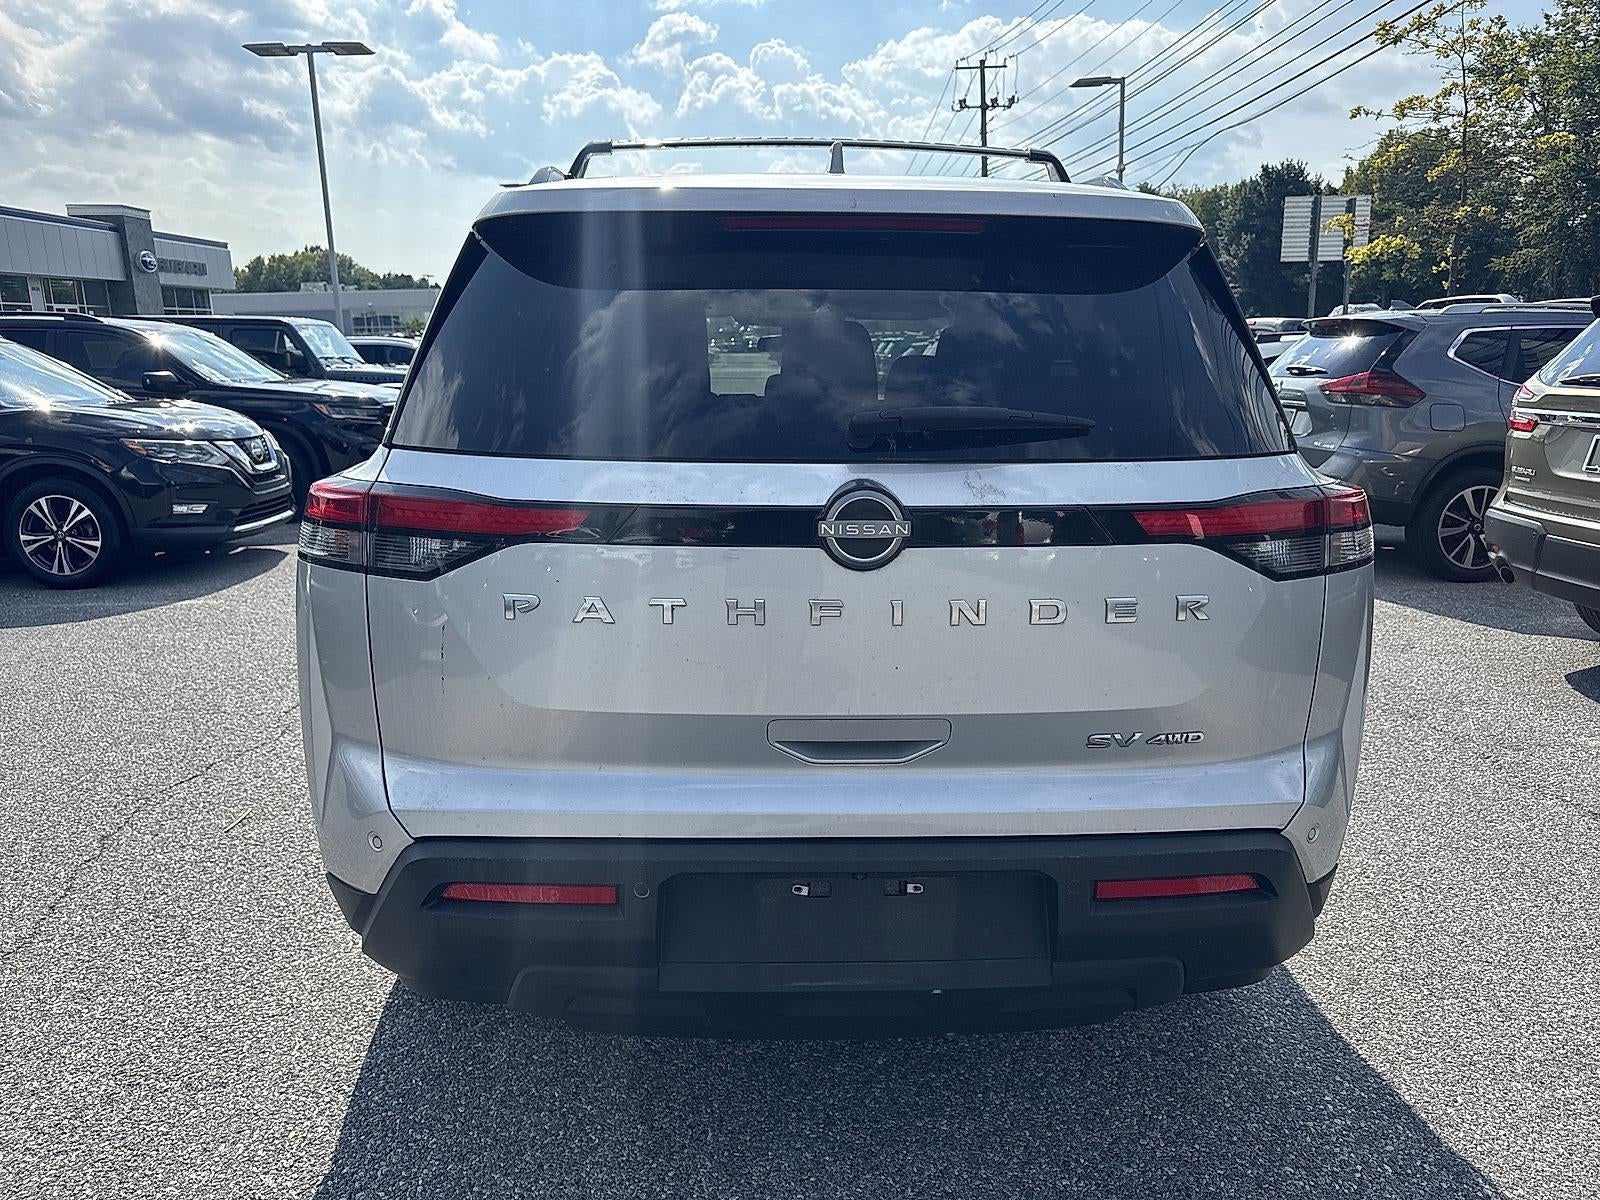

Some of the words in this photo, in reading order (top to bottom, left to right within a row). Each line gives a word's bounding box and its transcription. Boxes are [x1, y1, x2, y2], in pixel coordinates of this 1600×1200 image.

[157, 257, 208, 276] SUBARU
[820, 523, 909, 535] NISSAN
[502, 593, 1210, 626] PATHFINDER
[1086, 732, 1143, 749] SV
[1145, 731, 1205, 746] 4WD
